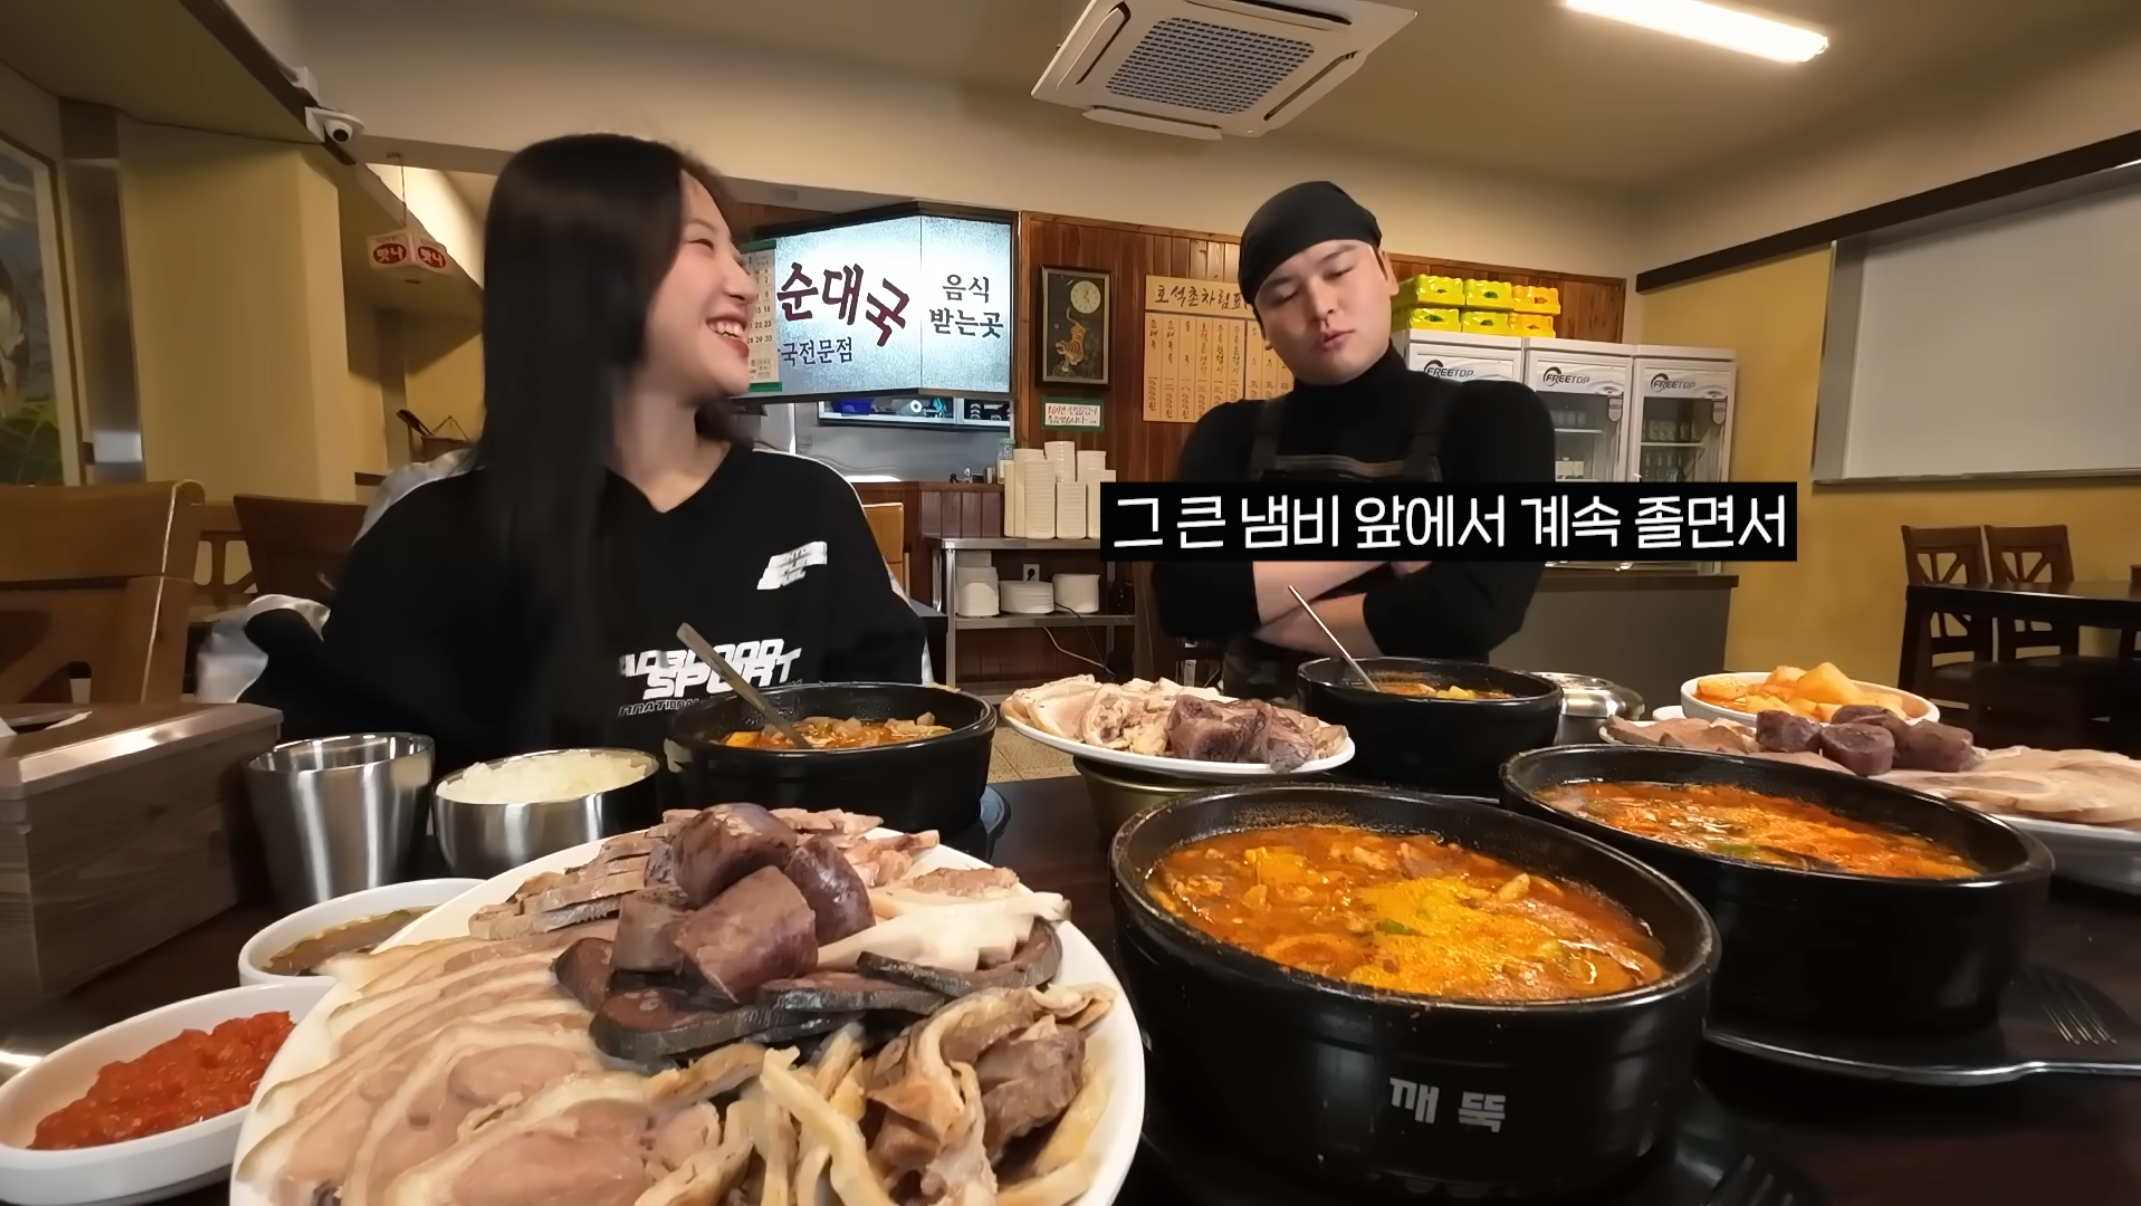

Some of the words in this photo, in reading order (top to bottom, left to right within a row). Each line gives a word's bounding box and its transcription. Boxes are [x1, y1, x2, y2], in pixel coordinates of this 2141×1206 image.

[942, 274, 990, 303] 음식
[777, 262, 910, 347] 순대국
[755, 321, 762, 329] 22
[764, 320, 772, 328] 23
[929, 307, 1004, 340] 받는곳
[777, 336, 853, 367] 국전문점
[1426, 366, 1474, 379] FREETOP
[1545, 373, 1590, 385] FREETOP
[1653, 380, 1696, 390] FREETOP
[642, 648, 802, 700] SPORT
[1389, 1077, 1440, 1124] 깨
[1458, 1091, 1506, 1133] 뚝
